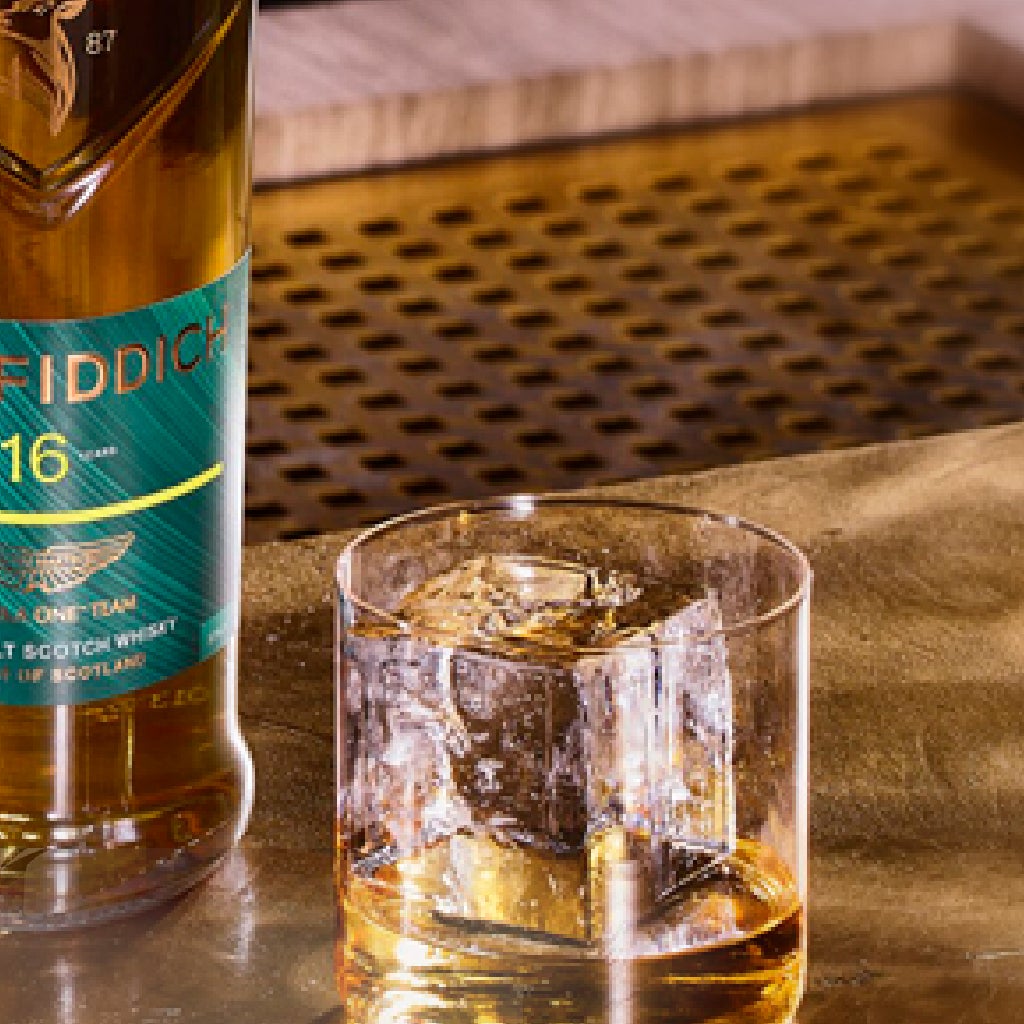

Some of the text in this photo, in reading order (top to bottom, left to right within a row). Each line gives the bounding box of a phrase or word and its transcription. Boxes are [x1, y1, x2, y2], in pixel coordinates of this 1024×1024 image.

[85, 28, 119, 56] 87
[0, 432, 71, 483] 16
[92, 593, 138, 617] TEAM
[21, 635, 111, 661] SCOTCH
[114, 616, 178, 649] WHISKY
[49, 653, 147, 684] SCOTLAND
